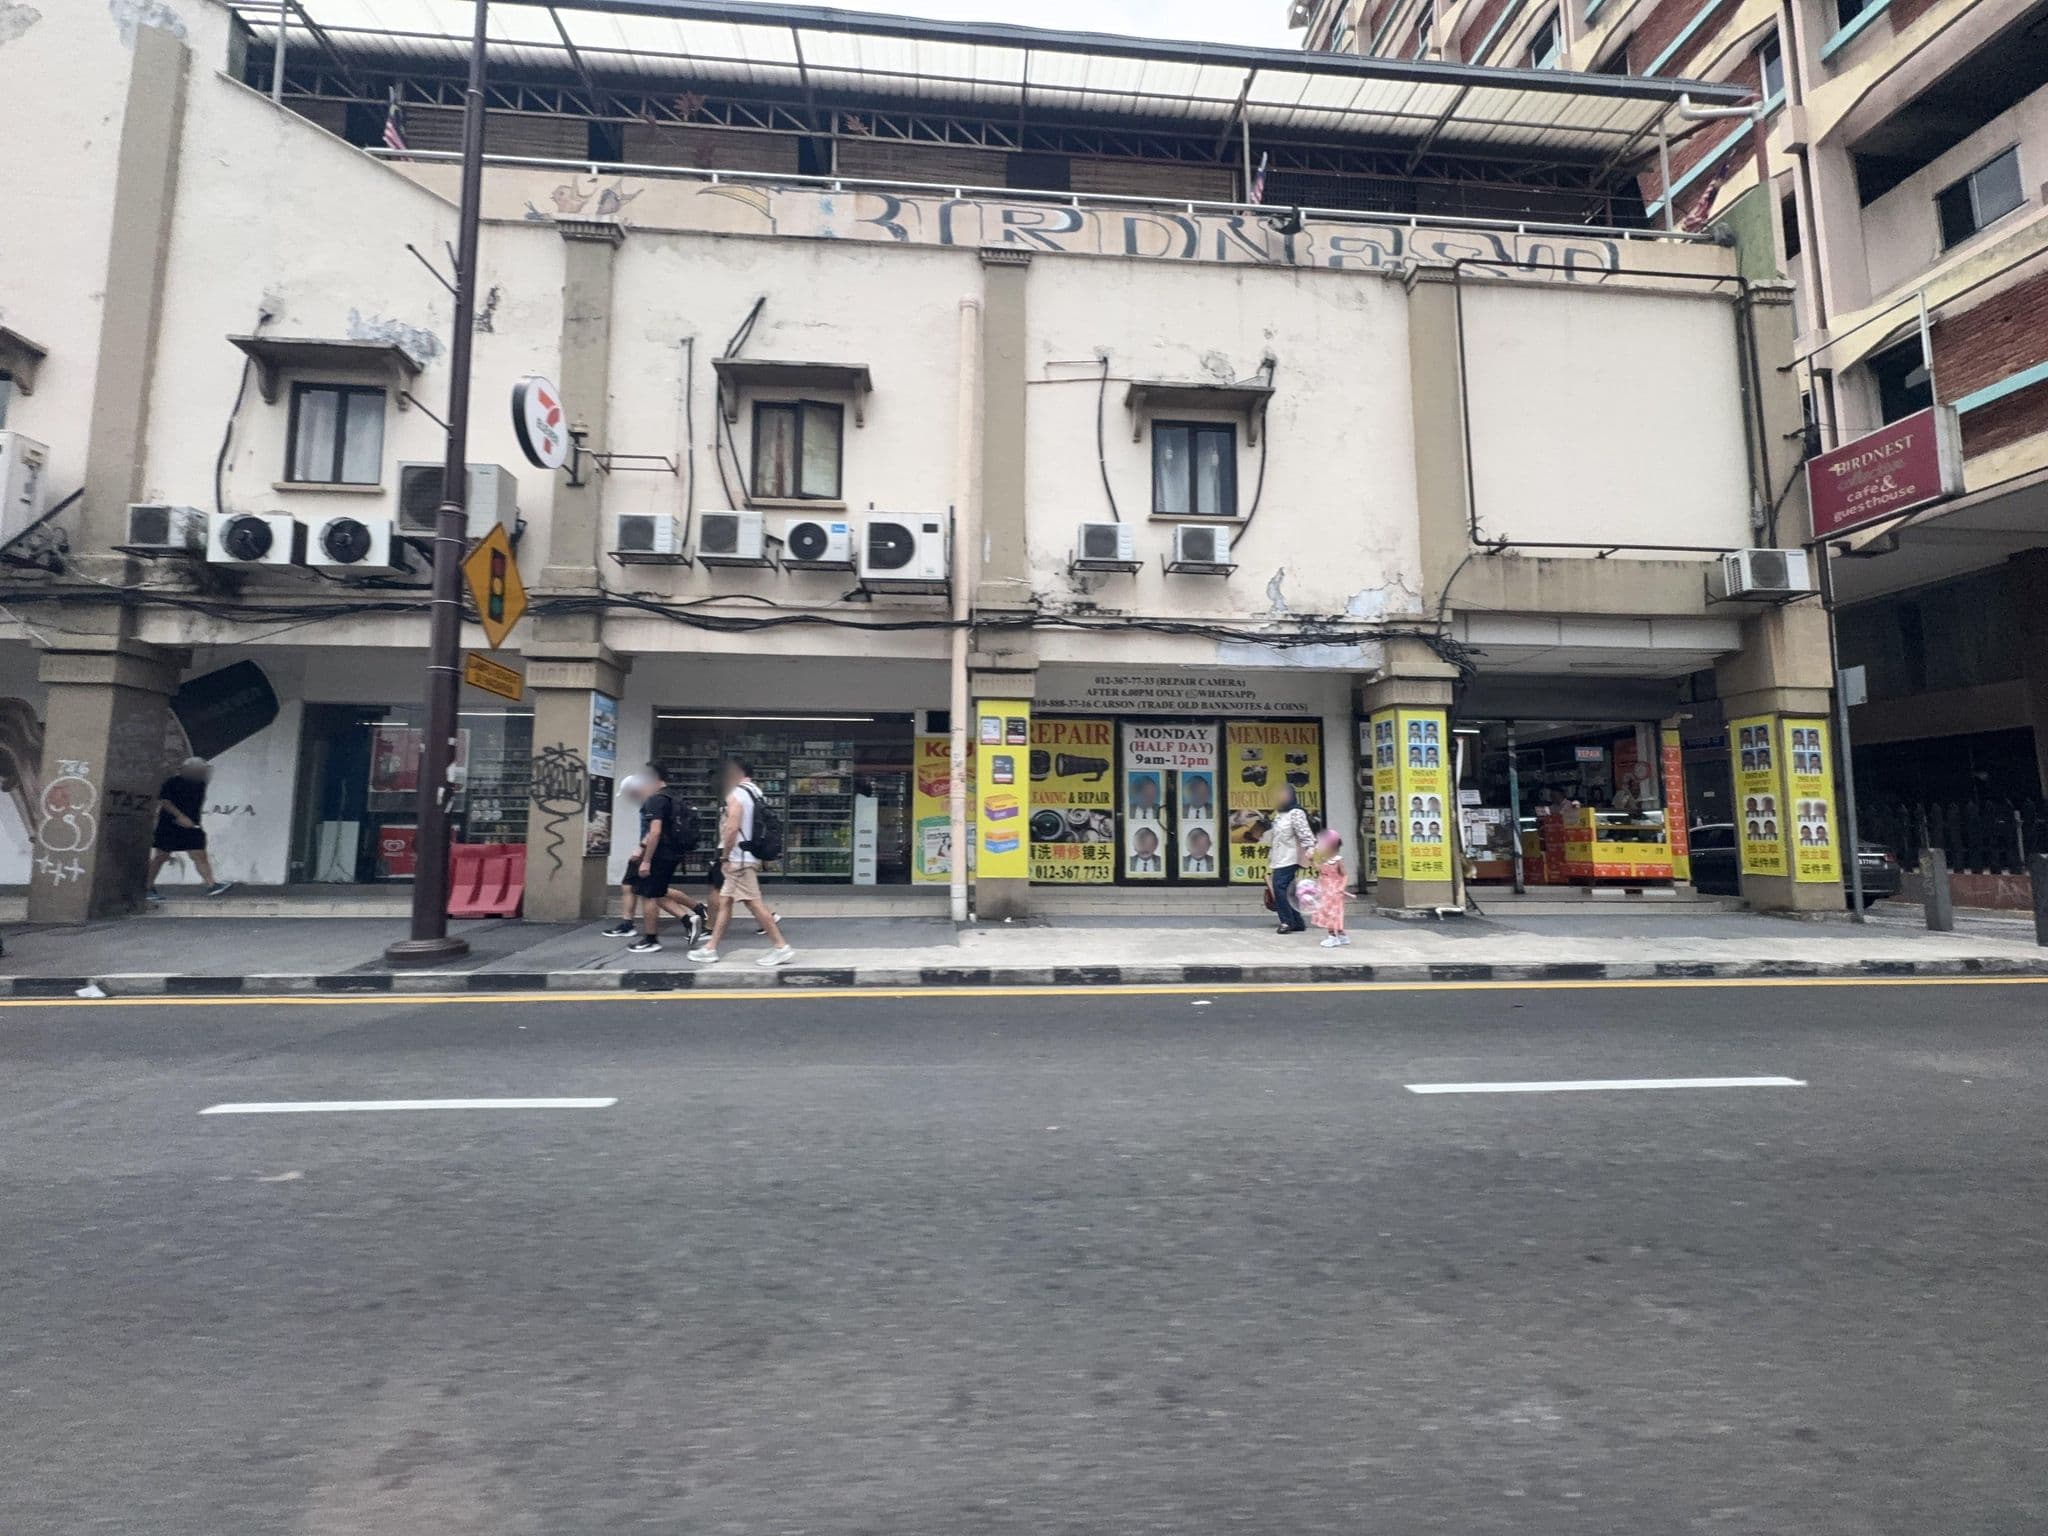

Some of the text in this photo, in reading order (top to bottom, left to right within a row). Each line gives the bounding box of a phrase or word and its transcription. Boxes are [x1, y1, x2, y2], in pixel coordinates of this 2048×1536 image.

[1829, 434, 1914, 476] BIRDNEST
[1880, 474, 1898, 492] &
[1834, 484, 1916, 522] guesthouse
[1087, 688, 1120, 697] AFTER
[1156, 689, 1184, 697] ONLY
[1094, 700, 1135, 709] CARSON
[1177, 701, 1199, 710] OLD
[1201, 702, 1262, 711] BANKNOTES
[1264, 702, 1272, 710] &
[1134, 728, 1209, 740] MONDAY
[1227, 726, 1318, 745] MEMBAIKI
[1129, 741, 1214, 755] (HALF DAY)
[1135, 754, 1209, 768] 9am-12pm
[1068, 791, 1076, 803] &
[1078, 791, 1111, 804] REPAIR
[1035, 865, 1109, 879] 012-367 7733
